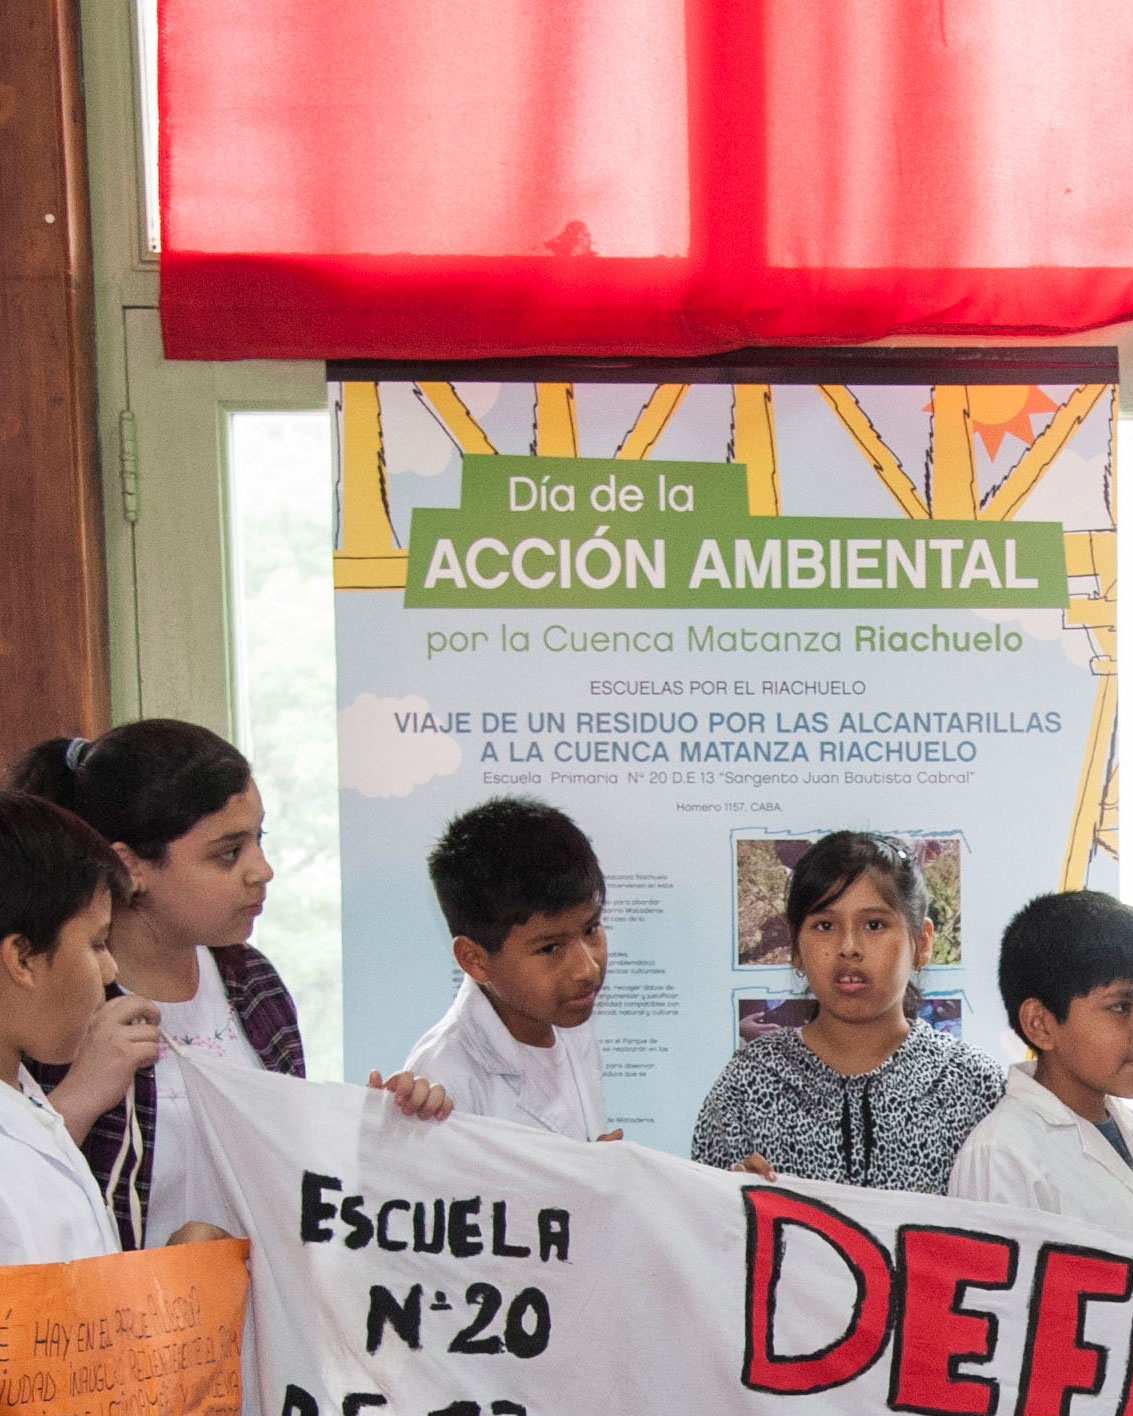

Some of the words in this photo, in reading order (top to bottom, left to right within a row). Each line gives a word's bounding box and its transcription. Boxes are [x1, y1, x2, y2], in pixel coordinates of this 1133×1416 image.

[508, 475, 575, 512] Día
[590, 474, 644, 512] de
[659, 474, 694, 512] la
[423, 525, 666, 590] ACCIÓN
[688, 538, 1039, 589] AMBIENTAL
[427, 630, 489, 660] por
[501, 624, 529, 652] la
[543, 625, 674, 652] Cuenca
[687, 625, 842, 652] Matanza
[855, 623, 1023, 652] Riachuelo
[590, 680, 684, 696] ESCUELAS
[690, 680, 727, 696] POR
[734, 680, 755, 696] EL
[762, 680, 866, 696] RIACHUELO
[394, 711, 472, 733] VIAJE
[482, 711, 518, 733] DE
[528, 711, 565, 733] UN
[577, 711, 699, 733] RESIDUO
[709, 711, 765, 734] POR
[776, 711, 829, 734] LAS
[839, 711, 1063, 734] ALCANTARILLAS
[480, 741, 500, 762] A
[509, 741, 545, 762] LA
[553, 741, 670, 762] CUENCA
[680, 741, 810, 763] MATANZA
[820, 741, 978, 763] RIACHUELO
[483, 771, 542, 784] Escuela
[551, 771, 619, 784] Primaria
[649, 771, 668, 784] 20
[700, 771, 716, 784] 13
[803, 772, 839, 785] Juan
[844, 771, 912, 784] Bautista
[676, 802, 723, 813] Homero
[301, 1169, 571, 1263] ESCUELA
